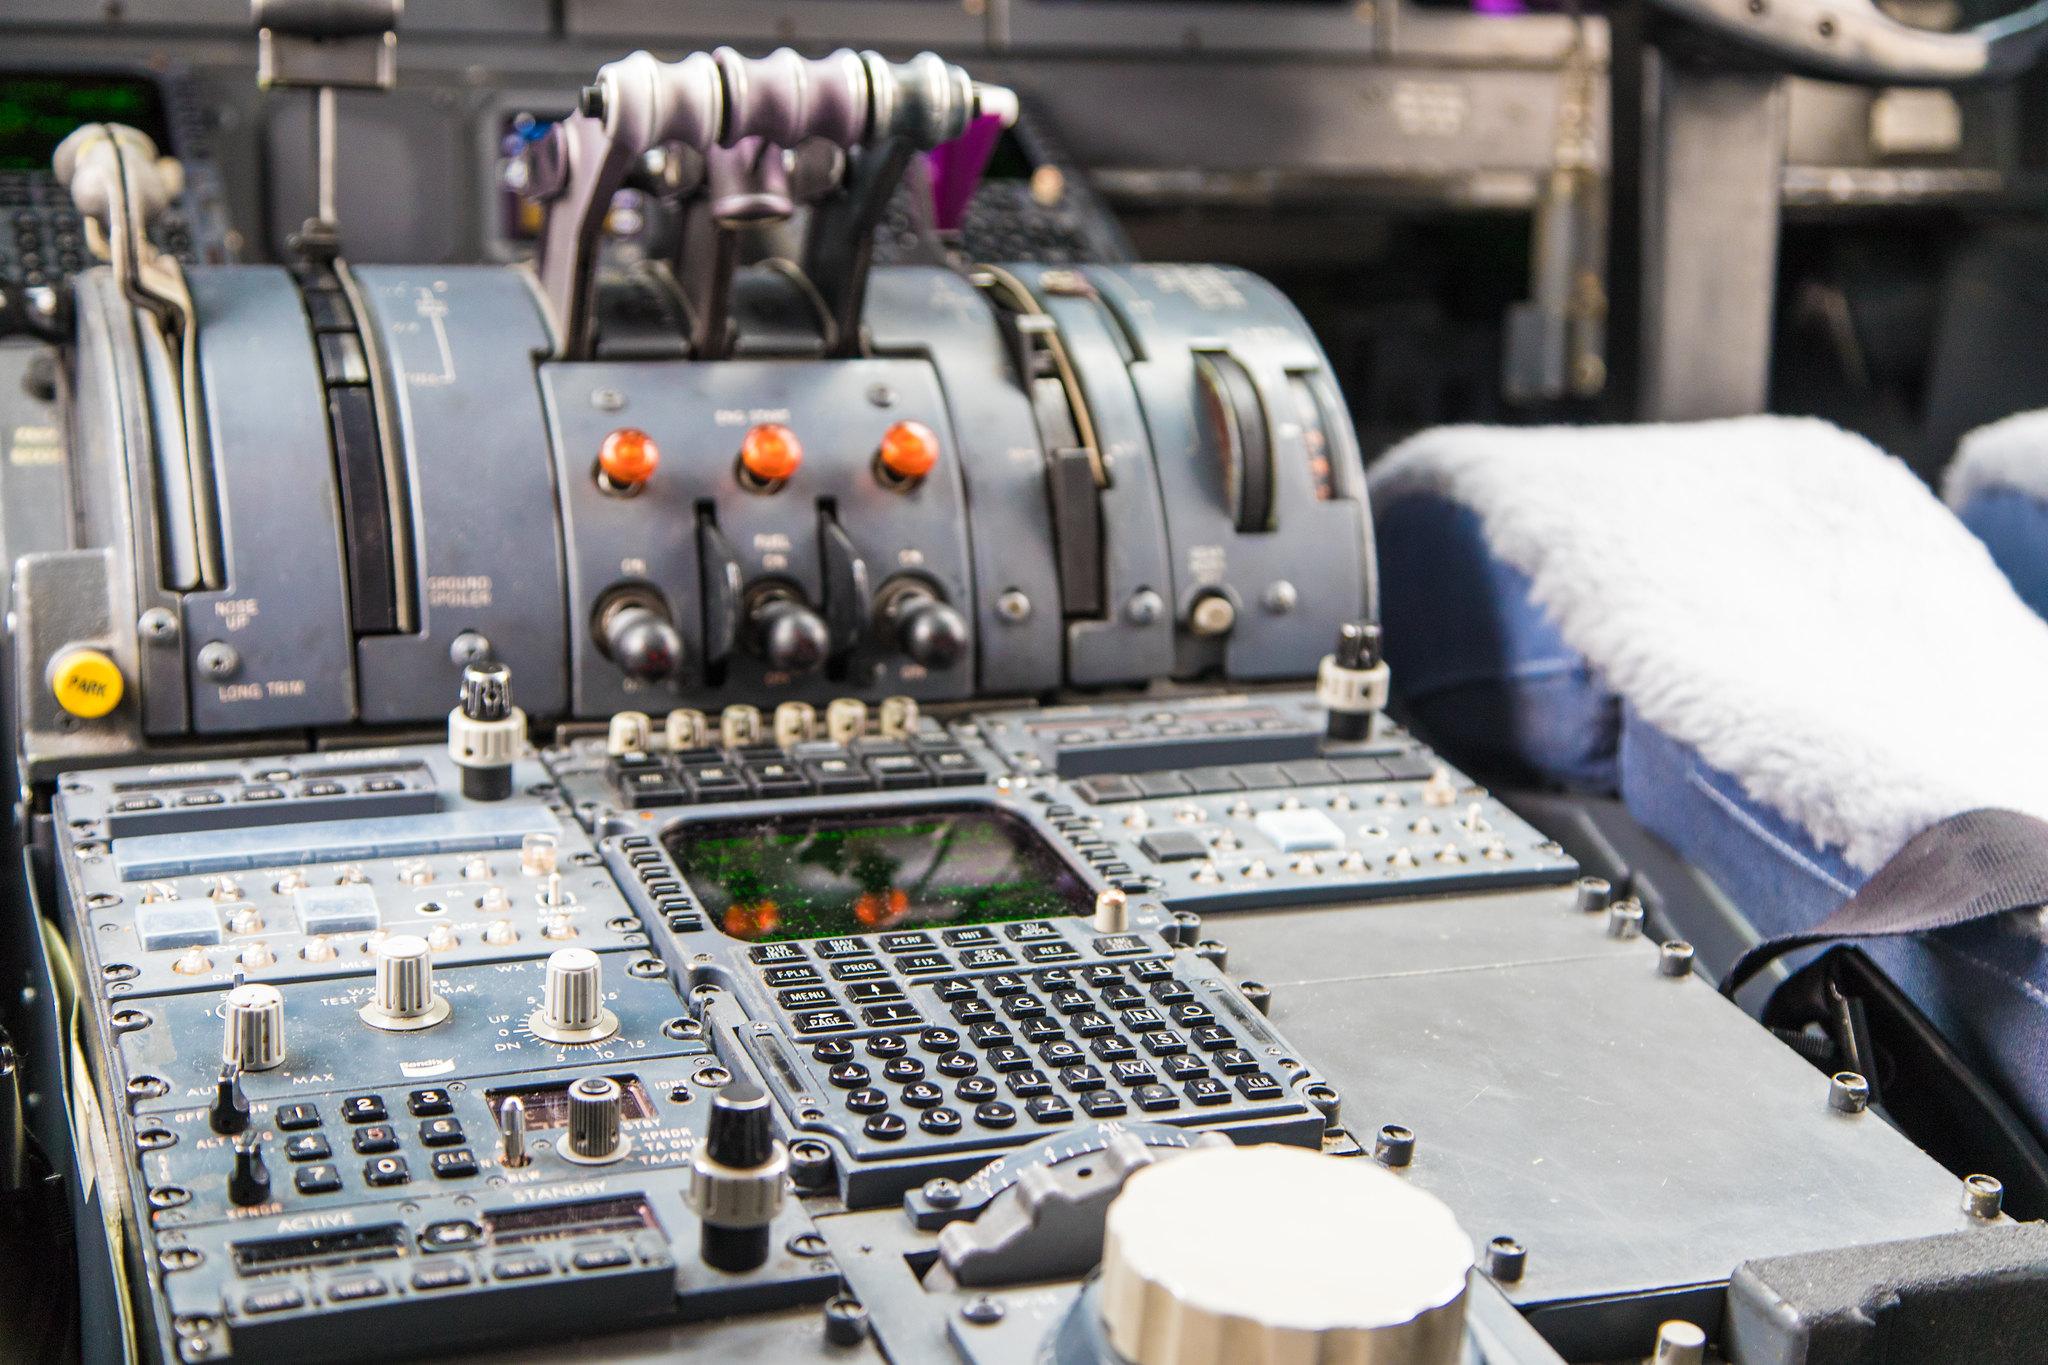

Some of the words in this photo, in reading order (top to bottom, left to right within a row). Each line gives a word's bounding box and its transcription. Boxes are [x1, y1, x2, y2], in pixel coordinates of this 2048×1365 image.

[427, 575, 492, 590] GROUND
[428, 590, 492, 607] SPOILER
[215, 599, 259, 616] NOSE
[226, 614, 250, 631] UP
[67, 676, 107, 697] PARK
[219, 683, 263, 702] LONG
[266, 680, 305, 697] TRIM
[958, 930, 982, 940] INIT
[892, 936, 921, 946] PERF
[1038, 945, 1062, 954] REF
[340, 961, 370, 969] MLS
[913, 957, 936, 966] FIX
[495, 963, 526, 973] WX
[843, 963, 876, 973] PROG
[1095, 967, 1111, 976] D
[1145, 963, 1158, 971] E
[1047, 971, 1065, 980] C
[950, 981, 967, 991] A
[998, 976, 1013, 986] B
[347, 987, 376, 996] WX
[439, 984, 477, 994] MAP
[1169, 984, 1179, 993] J
[790, 990, 826, 1001] MENU
[1064, 993, 1083, 1002] H
[320, 995, 358, 1007] TEST
[527, 997, 536, 1005] 5
[1015, 997, 1034, 1008] G
[967, 1003, 978, 1012] F
[1183, 1006, 1203, 1015] O
[488, 1014, 510, 1023] UP
[1134, 1010, 1151, 1021] N
[810, 1016, 841, 1026] PAGE
[1037, 1021, 1050, 1031] L
[1083, 1016, 1105, 1026] M
[498, 1028, 509, 1036] 0
[983, 1026, 1000, 1036] K
[1206, 1030, 1219, 1039] T
[934, 1032, 948, 1042] 3
[1157, 1034, 1172, 1044] S
[495, 1041, 522, 1051] DN
[627, 1040, 646, 1049] 15
[829, 1041, 841, 1052] 1
[879, 1037, 895, 1048] 2
[1106, 1039, 1122, 1049] R
[1053, 1045, 1074, 1054] Q
[556, 1054, 566, 1062] 5
[597, 1051, 615, 1060] 10
[951, 1055, 965, 1065] 6
[1002, 1050, 1014, 1060] P
[1227, 1053, 1242, 1063] Y
[400, 1057, 443, 1069] Bendix
[900, 1061, 913, 1072] 5
[1121, 1063, 1144, 1073] W
[1178, 1058, 1196, 1069] X
[844, 1066, 858, 1077] 4
[1073, 1069, 1088, 1079] V
[292, 1072, 335, 1086] MAX
[1020, 1074, 1038, 1084] U
[1247, 1077, 1272, 1087] CLR
[654, 1079, 688, 1091] IDNT
[968, 1080, 982, 1092] 9
[1199, 1084, 1216, 1093] SP
[915, 1085, 932, 1097] 8
[421, 1091, 439, 1103] 3
[858, 1091, 871, 1104] 7
[357, 1098, 375, 1111] 2
[1042, 1100, 1060, 1111] Z
[175, 1111, 204, 1124] OFF
[295, 1106, 304, 1119] 1
[433, 1120, 450, 1133] 6
[623, 1118, 661, 1131] STBY
[639, 1127, 692, 1142] XPNDR
[197, 1136, 227, 1150] ALT
[299, 1136, 317, 1150] 4
[647, 1141, 667, 1152] TA
[438, 1151, 471, 1165] CLR
[308, 1166, 325, 1181] 7
[512, 1180, 607, 1203] STANDBY
[277, 1212, 355, 1233] ACTIVE
